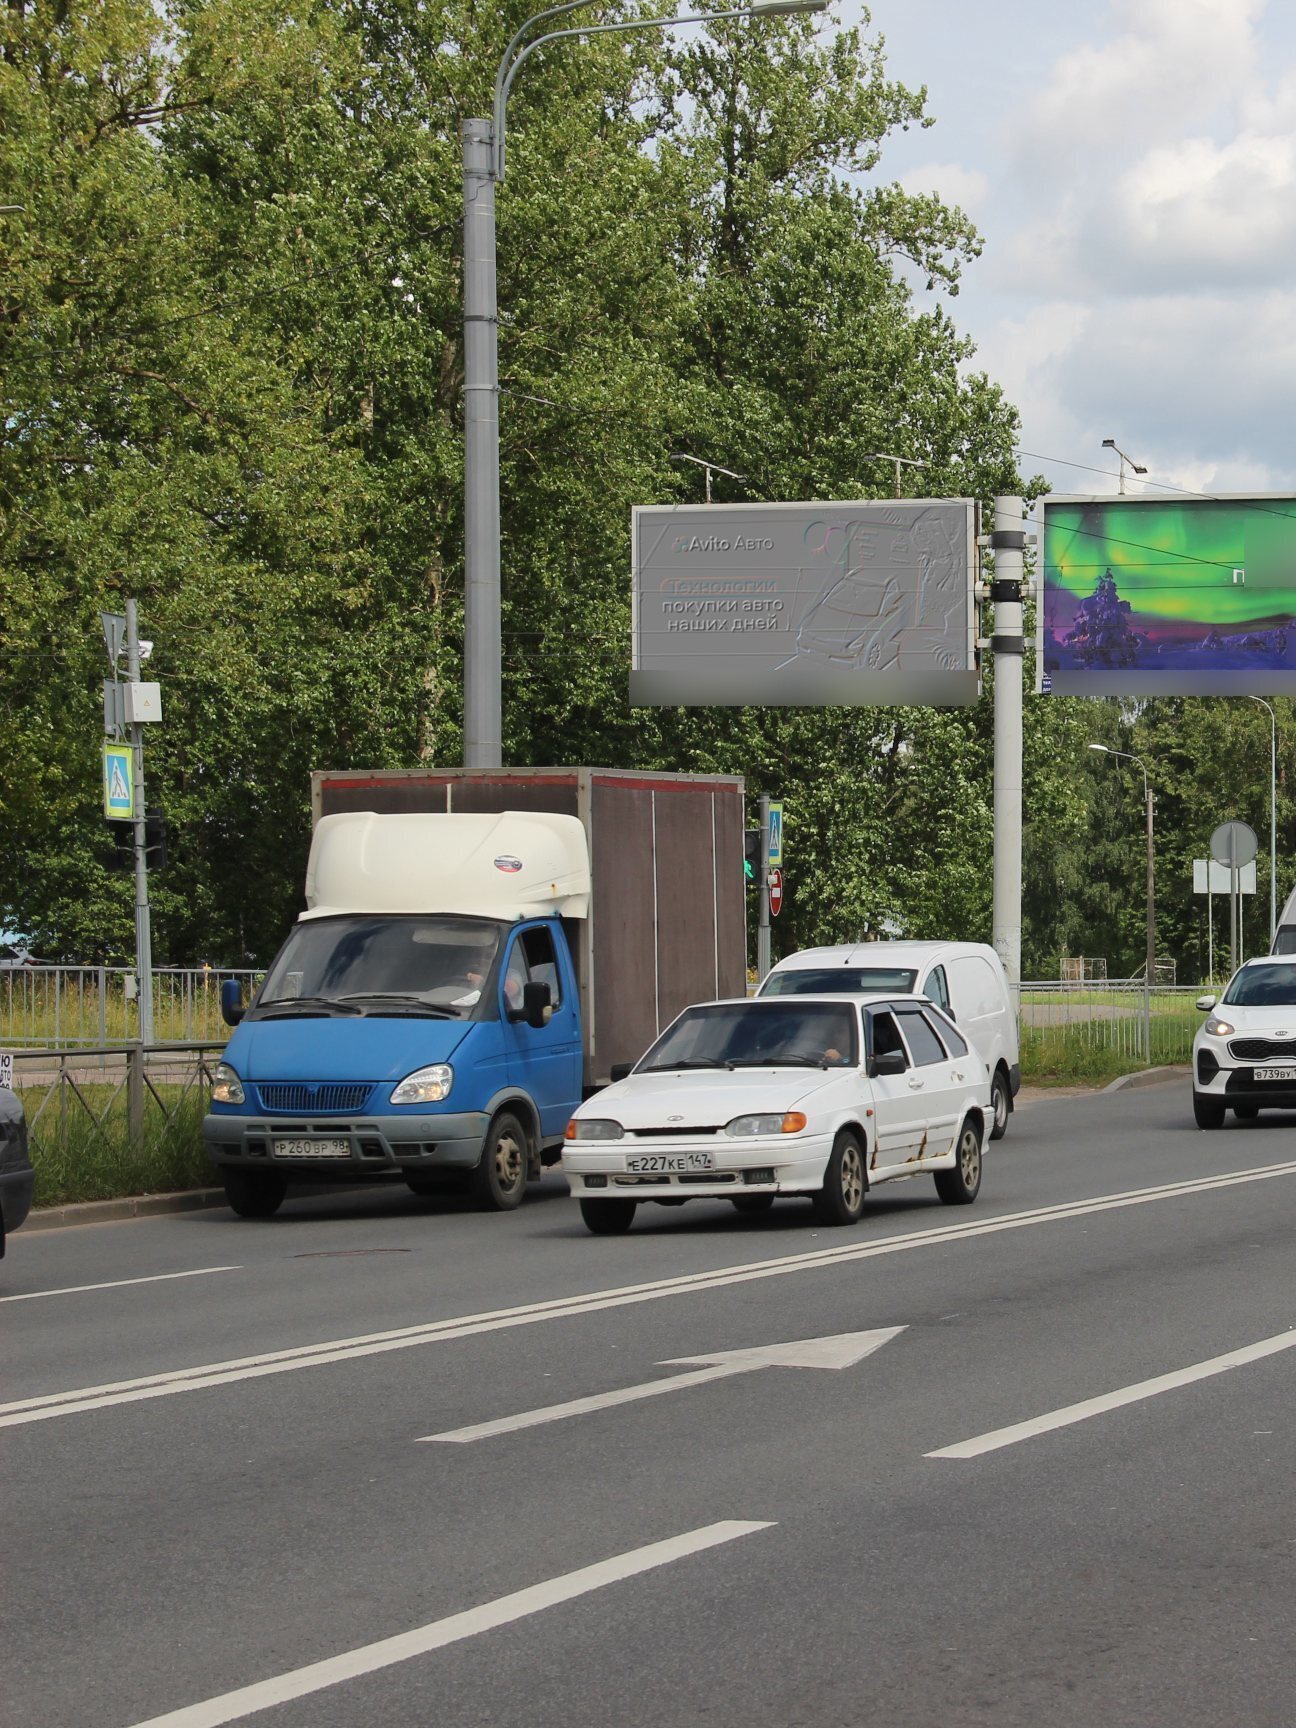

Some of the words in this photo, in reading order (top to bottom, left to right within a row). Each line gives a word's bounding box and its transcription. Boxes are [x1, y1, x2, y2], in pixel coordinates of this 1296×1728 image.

[689, 535, 731, 552] Avito
[733, 535, 775, 551] Авто
[672, 580, 777, 594] Технологии
[662, 600, 739, 616] покупки
[742, 599, 784, 612] авто
[667, 619, 728, 631] наших
[731, 613, 779, 632] дней
[632, 1156, 686, 1171] Е227КЕ
[688, 1154, 708, 1165] 147
